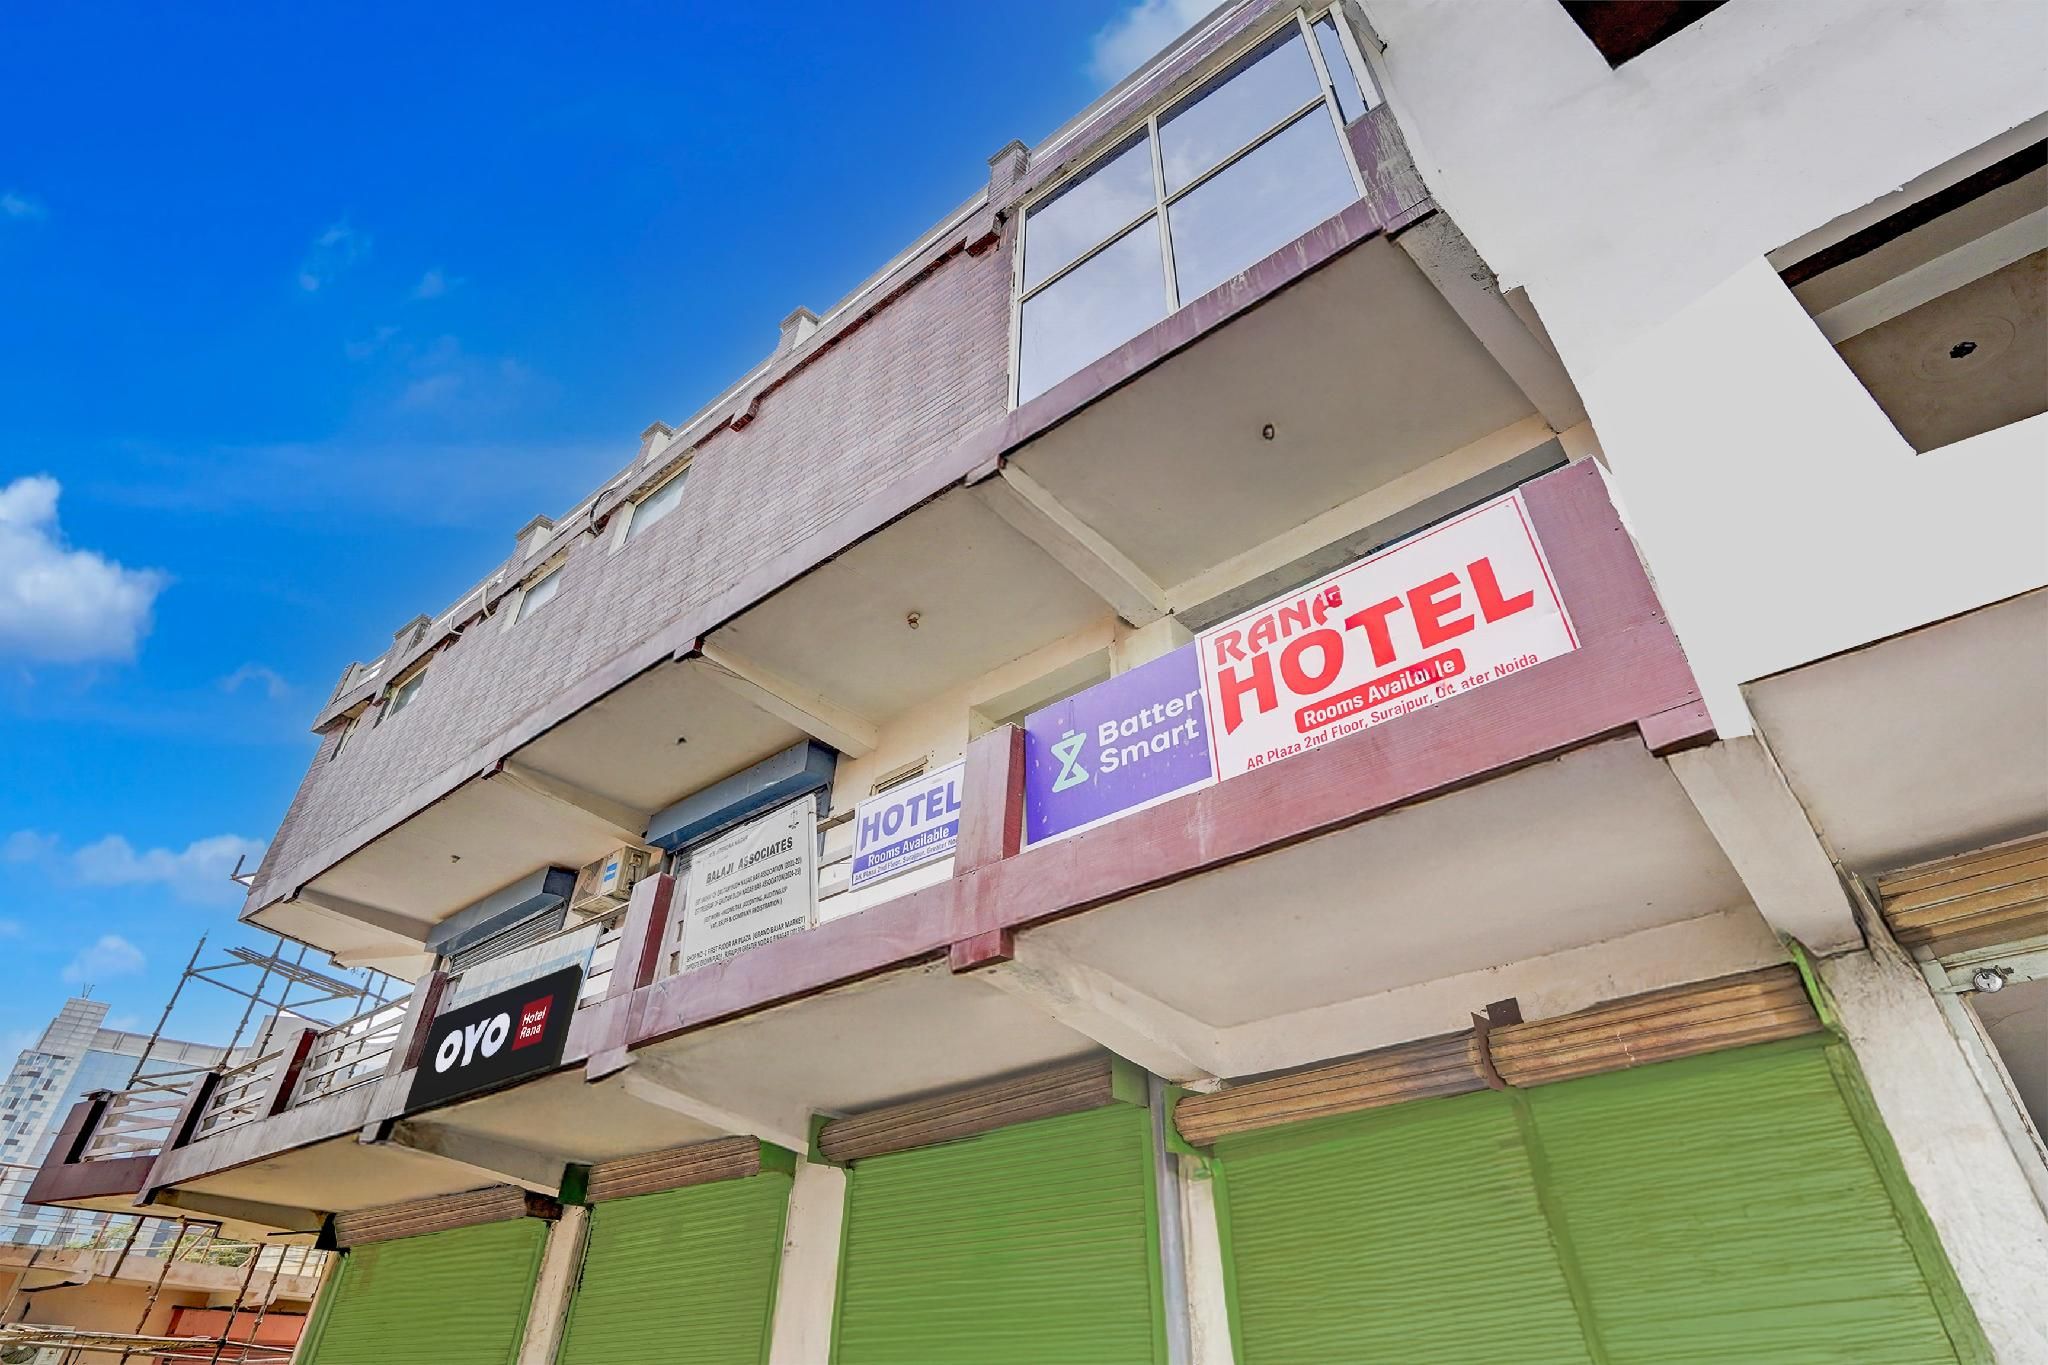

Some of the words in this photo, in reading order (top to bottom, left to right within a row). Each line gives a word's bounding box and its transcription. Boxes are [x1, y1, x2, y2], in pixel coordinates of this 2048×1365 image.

[1217, 556, 1534, 735] HOTEL
[1098, 687, 1203, 748] Batter
[1246, 754, 1264, 770] AR
[1267, 742, 1302, 766] Plaza
[1304, 729, 1328, 750] 2nd
[1331, 717, 1369, 742] Floor,
[1370, 693, 1435, 725] Surajpur,
[1495, 654, 1538, 677] Noida
[1303, 694, 1364, 728] Rooms
[1368, 658, 1455, 704] Availale
[1099, 715, 1200, 776] Smart
[860, 780, 961, 852] HOTEL
[868, 846, 900, 866] Rooms
[902, 826, 949, 853] Available
[707, 863, 734, 883] BALAJI
[738, 837, 792, 869] ASSOCIATES
[435, 1012, 511, 1073] OYO
[520, 1024, 541, 1039] Rana
[522, 1007, 547, 1025] Hotel
